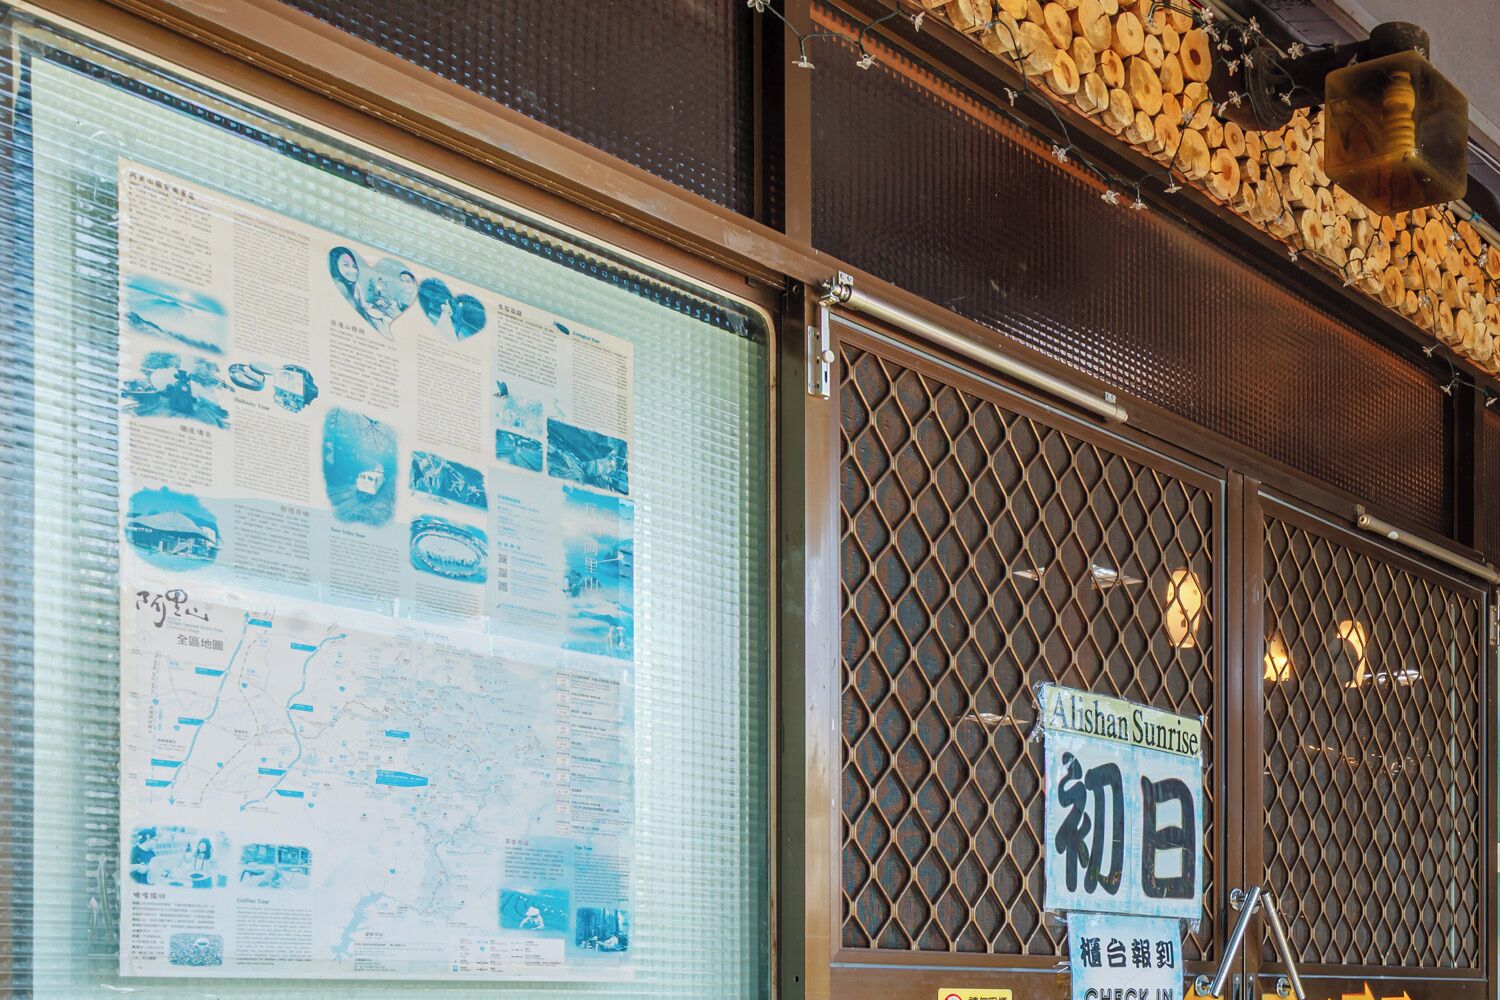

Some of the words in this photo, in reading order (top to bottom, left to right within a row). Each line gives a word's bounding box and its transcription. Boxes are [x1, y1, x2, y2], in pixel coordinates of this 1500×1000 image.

[176, 633, 224, 651] 全區地圖
[1050, 692, 1129, 741] Alishan
[1132, 709, 1199, 756] Sunrise
[1054, 751, 1196, 899] 初日
[1080, 936, 1175, 969] 櫃台報到
